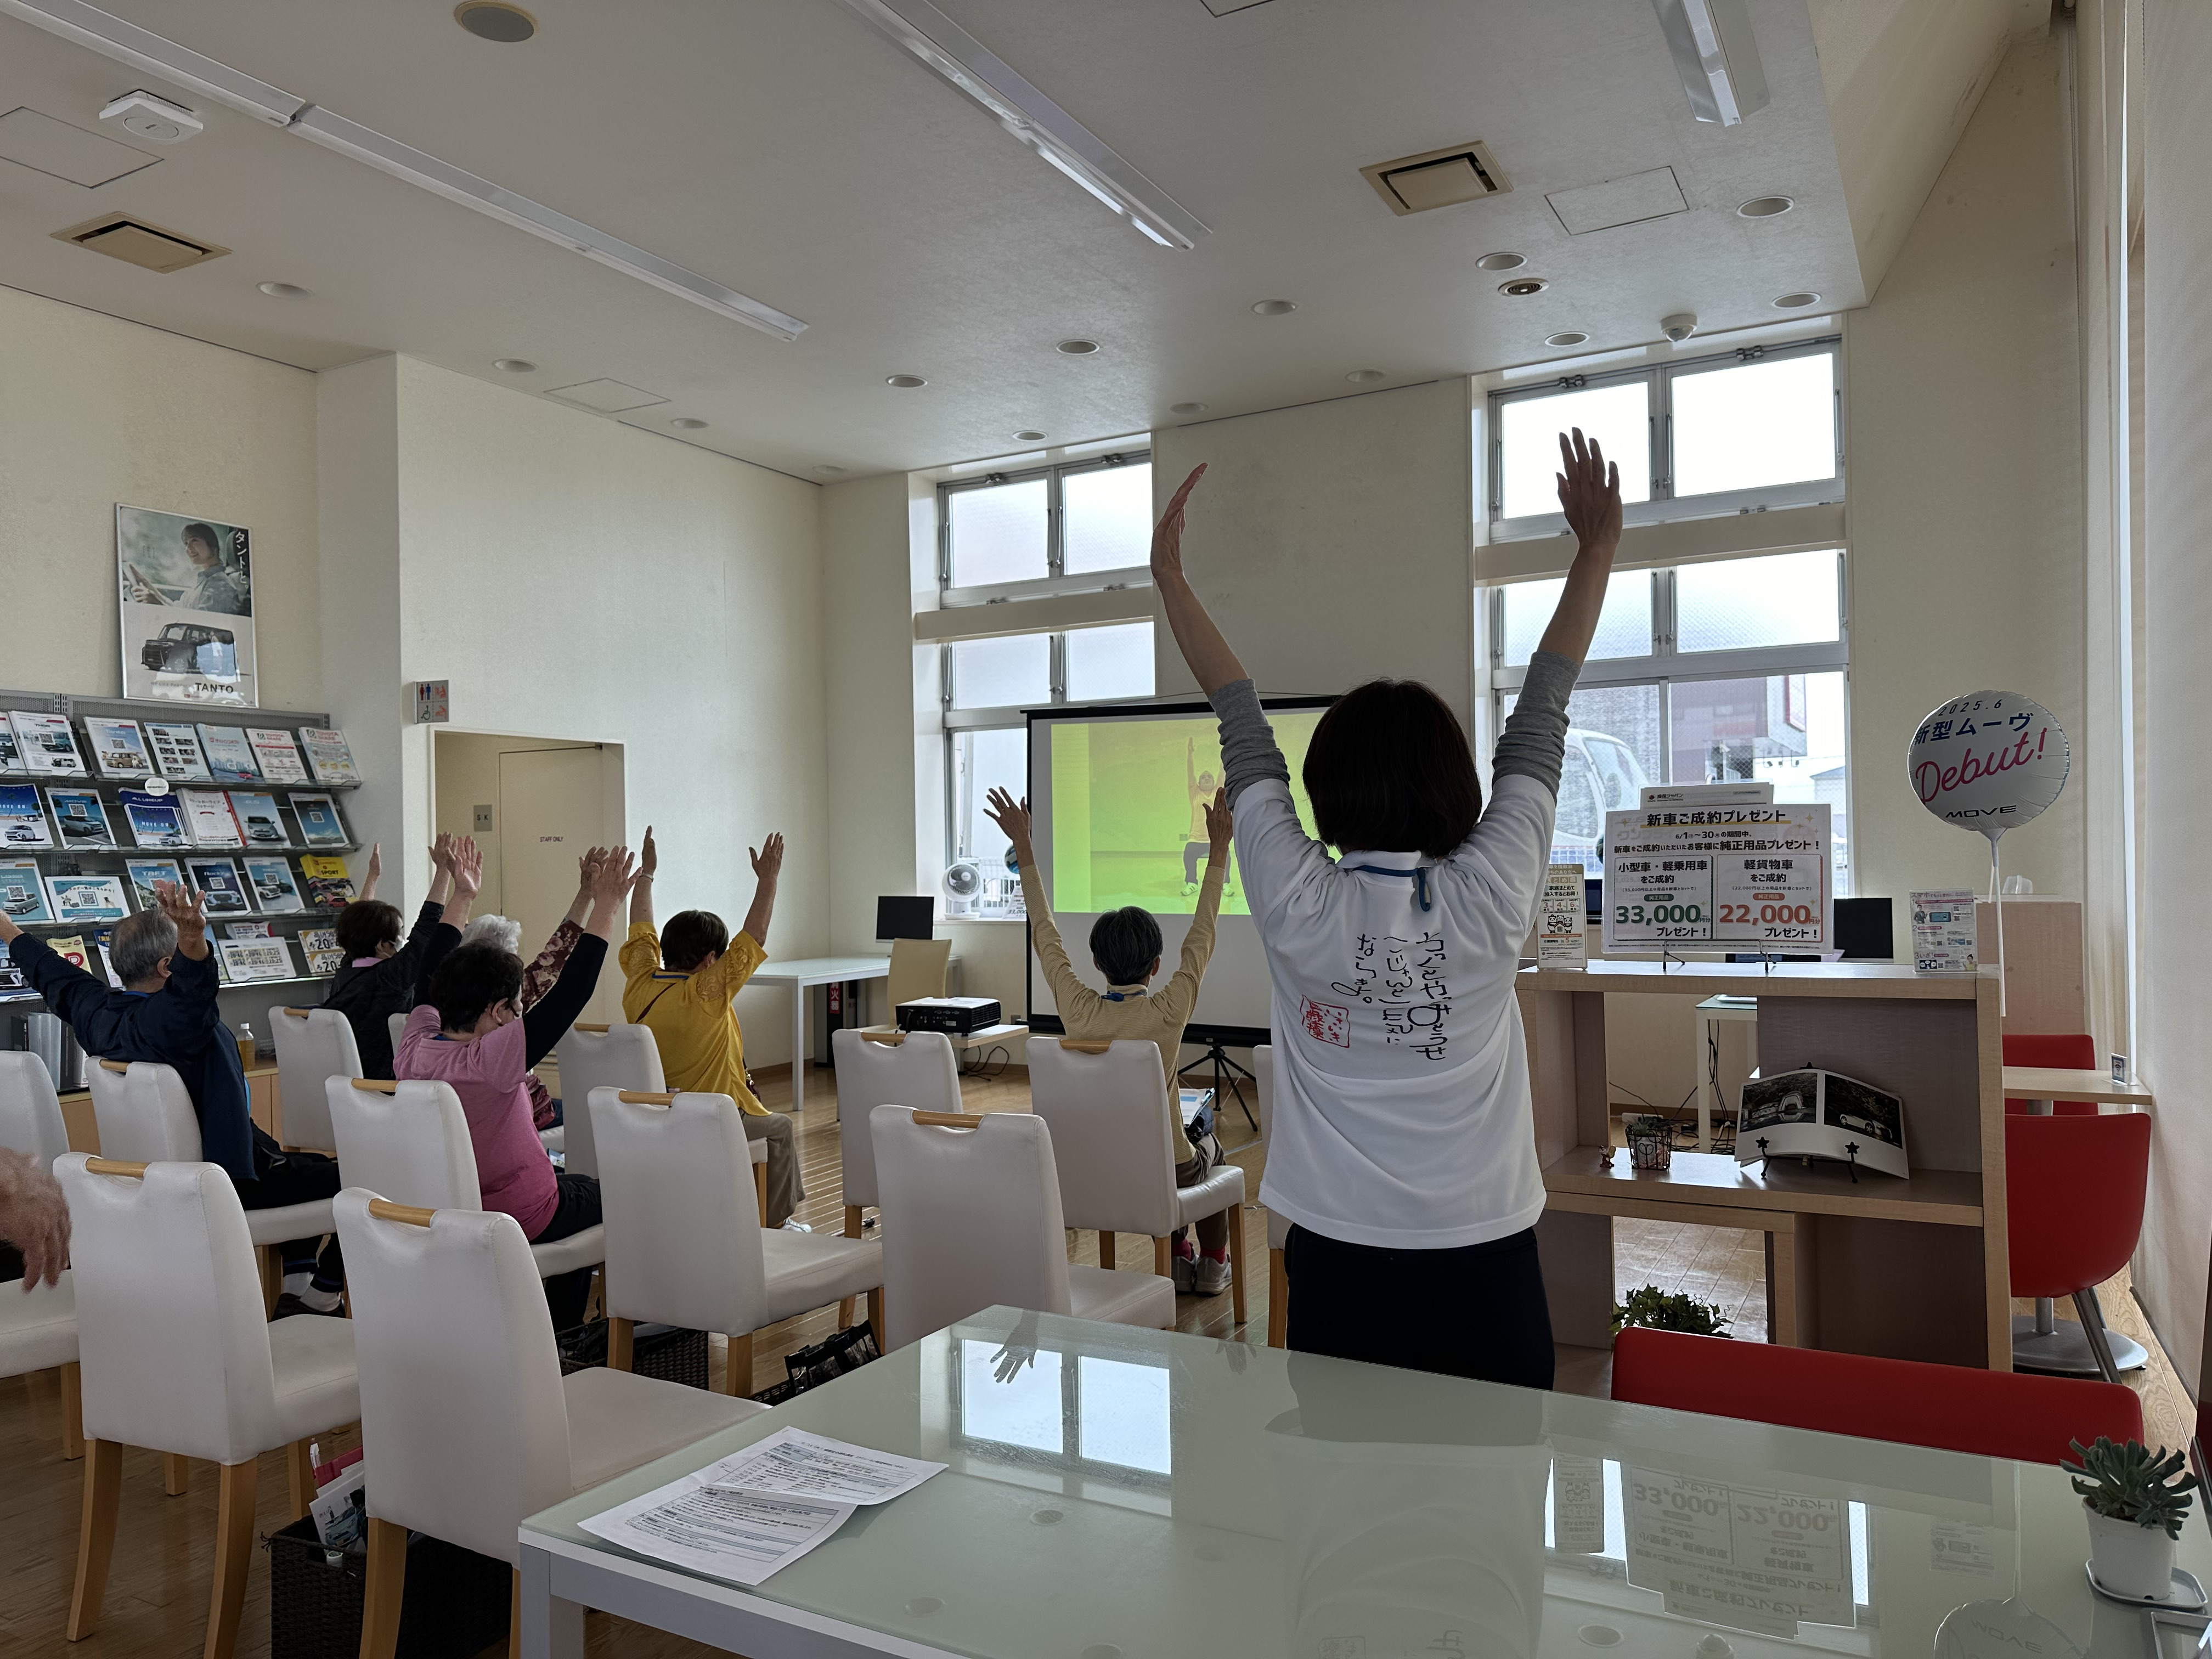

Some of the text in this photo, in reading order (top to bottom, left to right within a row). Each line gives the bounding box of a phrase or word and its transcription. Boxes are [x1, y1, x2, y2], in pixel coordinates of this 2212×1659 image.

[195, 682, 234, 694] TANTO
[1938, 699, 2003, 716] 2025.6
[1914, 712, 2034, 746] 新型ムーヴ
[1915, 727, 2047, 804] Debut!
[1945, 804, 2017, 818] MOVE
[1646, 809, 1786, 827] 新車ご成約プレゼント
[1618, 860, 1708, 872] 小型車・軽乗用車
[1743, 859, 1793, 870] 軽貨物車
[1640, 874, 1674, 884] をご成約
[1750, 873, 1787, 883] をご成約
[1656, 927, 1706, 937] プレゼント！
[1764, 927, 1817, 938] プレゼント！
